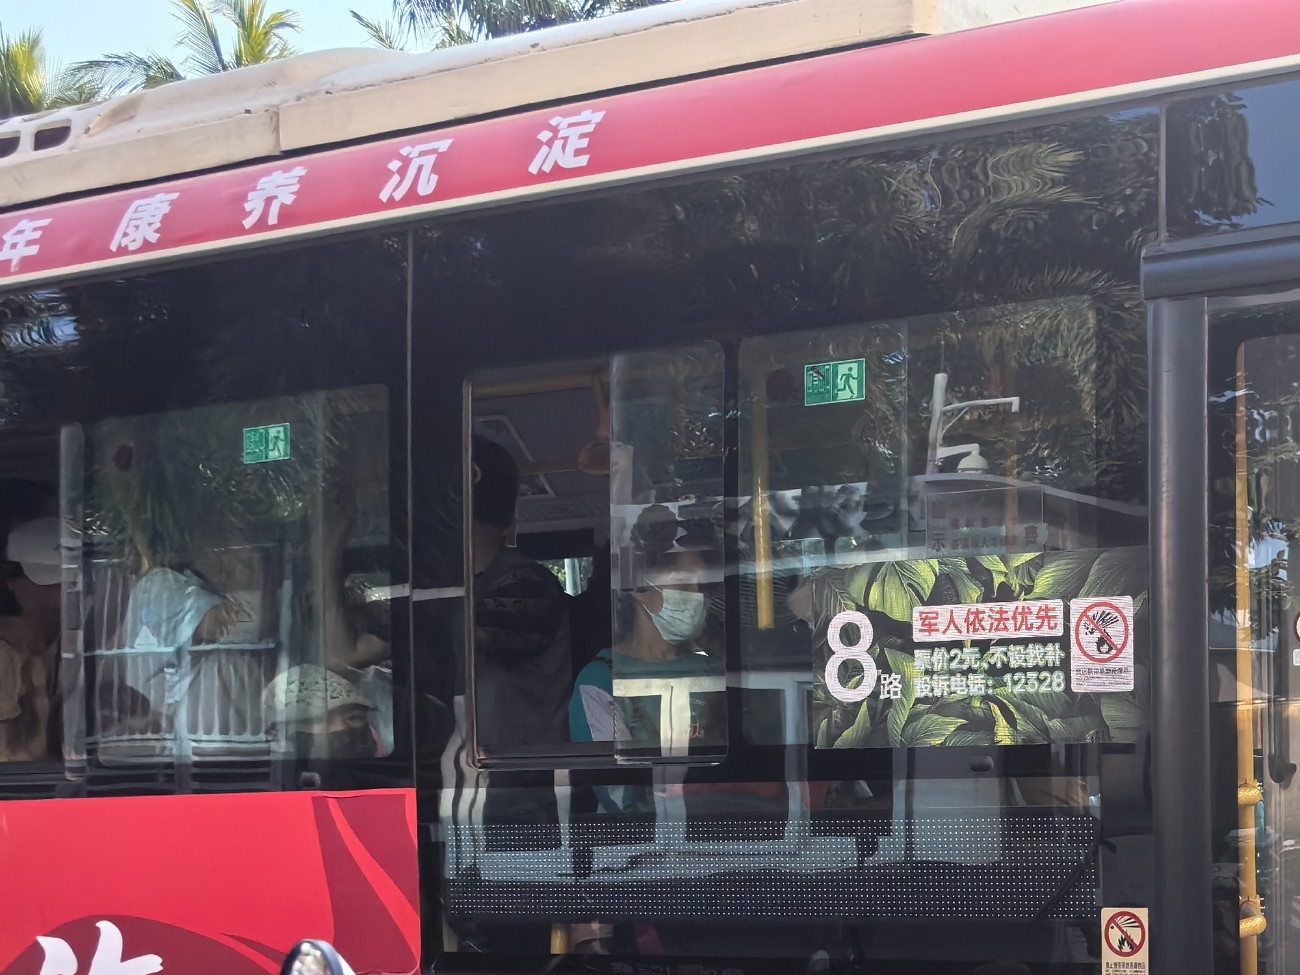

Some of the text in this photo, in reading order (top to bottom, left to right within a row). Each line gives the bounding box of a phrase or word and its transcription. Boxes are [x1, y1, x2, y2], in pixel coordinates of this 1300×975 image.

[918, 604, 1058, 635] 军人依法优先
[825, 610, 902, 702] 8路
